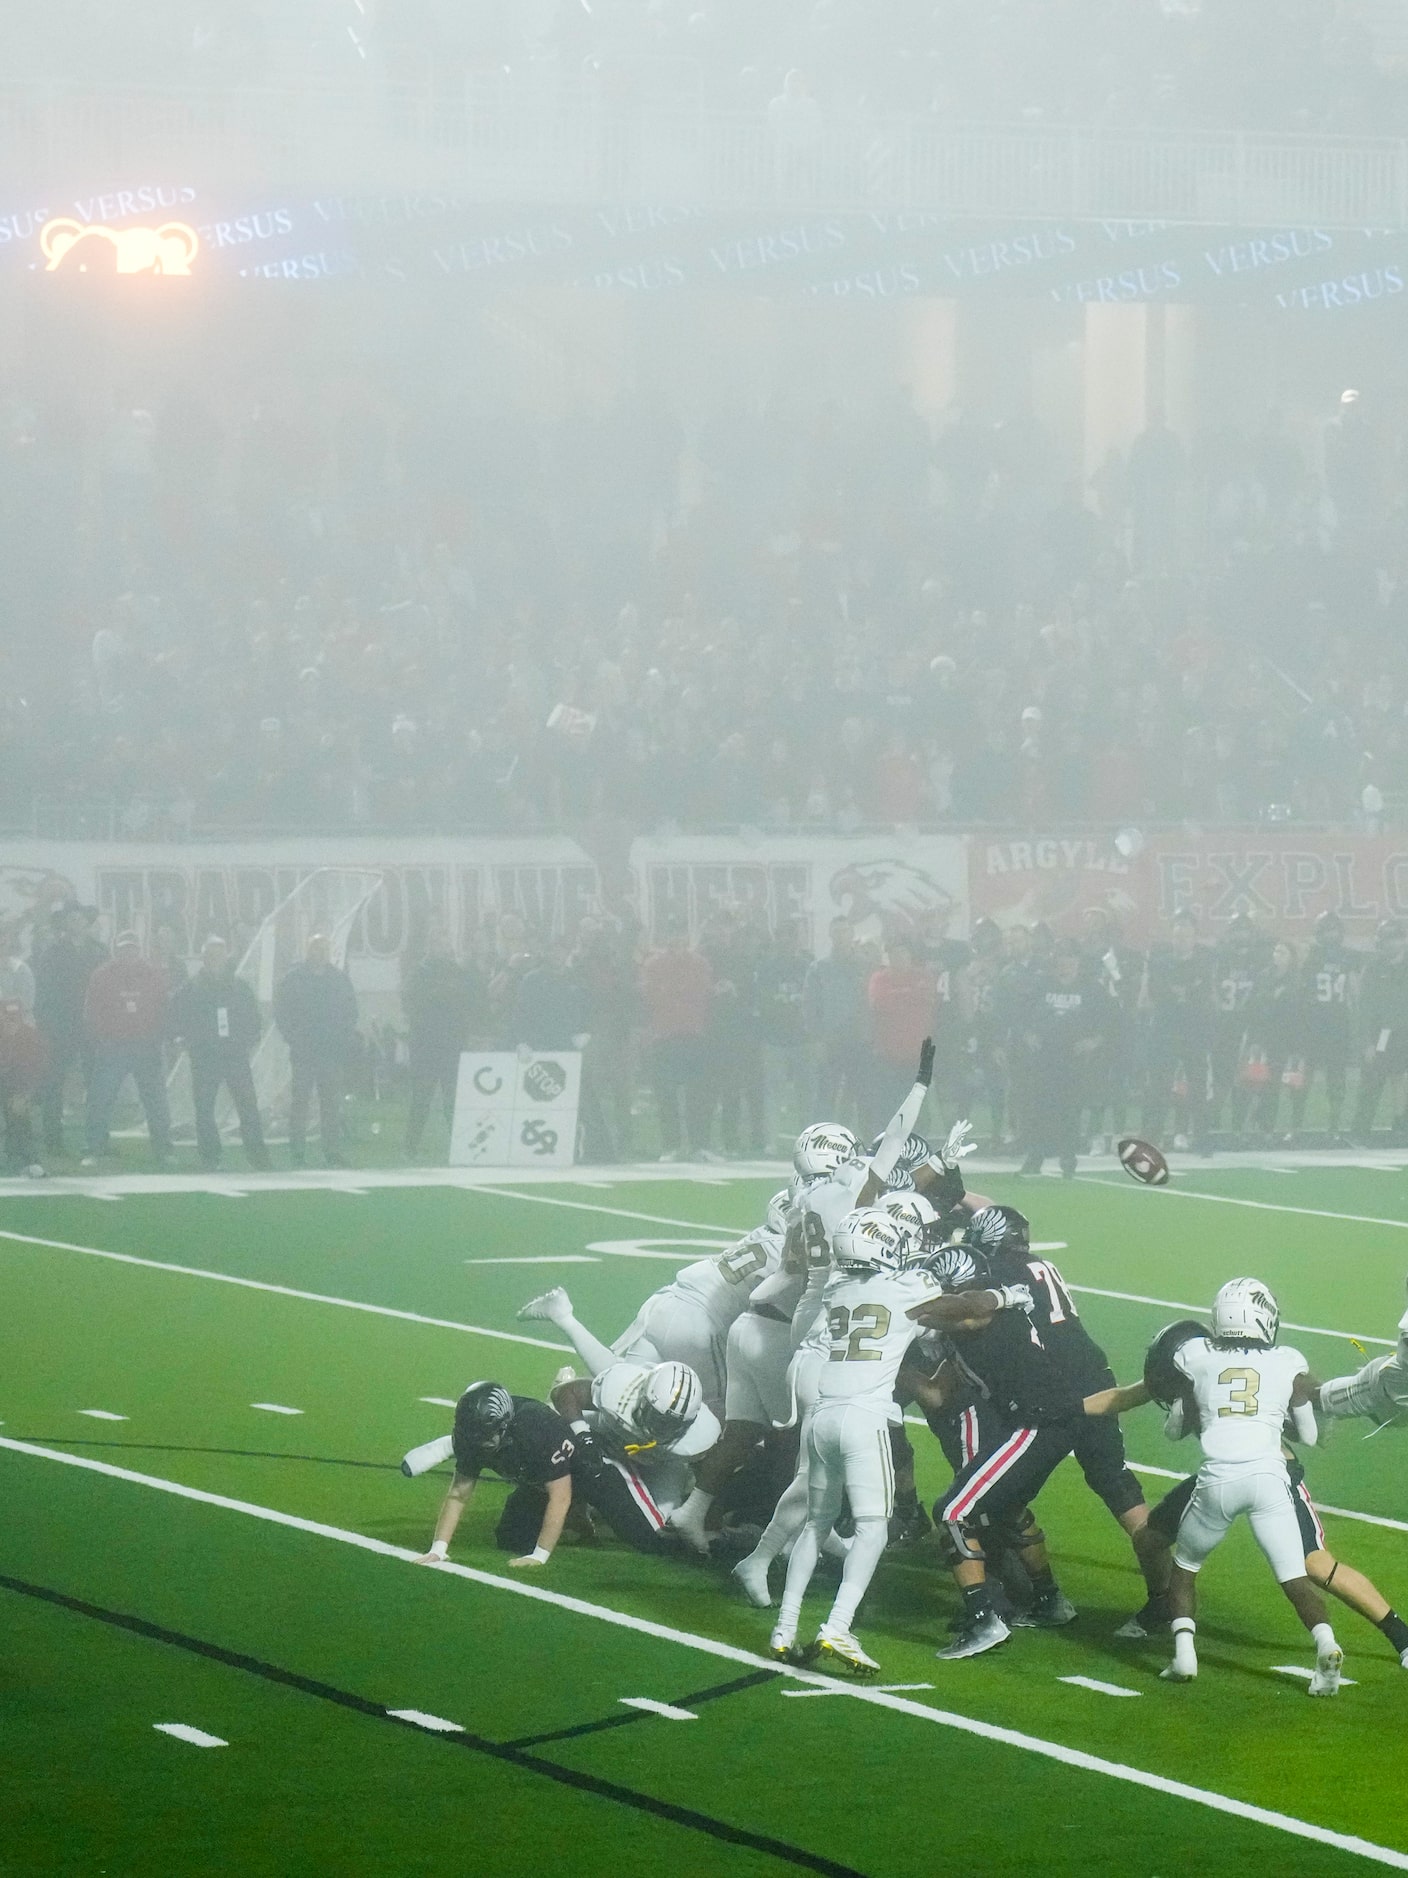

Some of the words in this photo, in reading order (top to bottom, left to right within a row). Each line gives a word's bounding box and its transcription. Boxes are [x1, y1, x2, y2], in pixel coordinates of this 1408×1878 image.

[74, 186, 197, 222] VERSUS
[432, 223, 574, 274] VERSUS
[710, 220, 846, 273] VERSUS
[943, 229, 1076, 279] VERSUS
[1203, 228, 1334, 276] VERSUS
[528, 1064, 562, 1096] STOP
[811, 1134, 848, 1153] Mecca
[1218, 1368, 1261, 1418] 3
